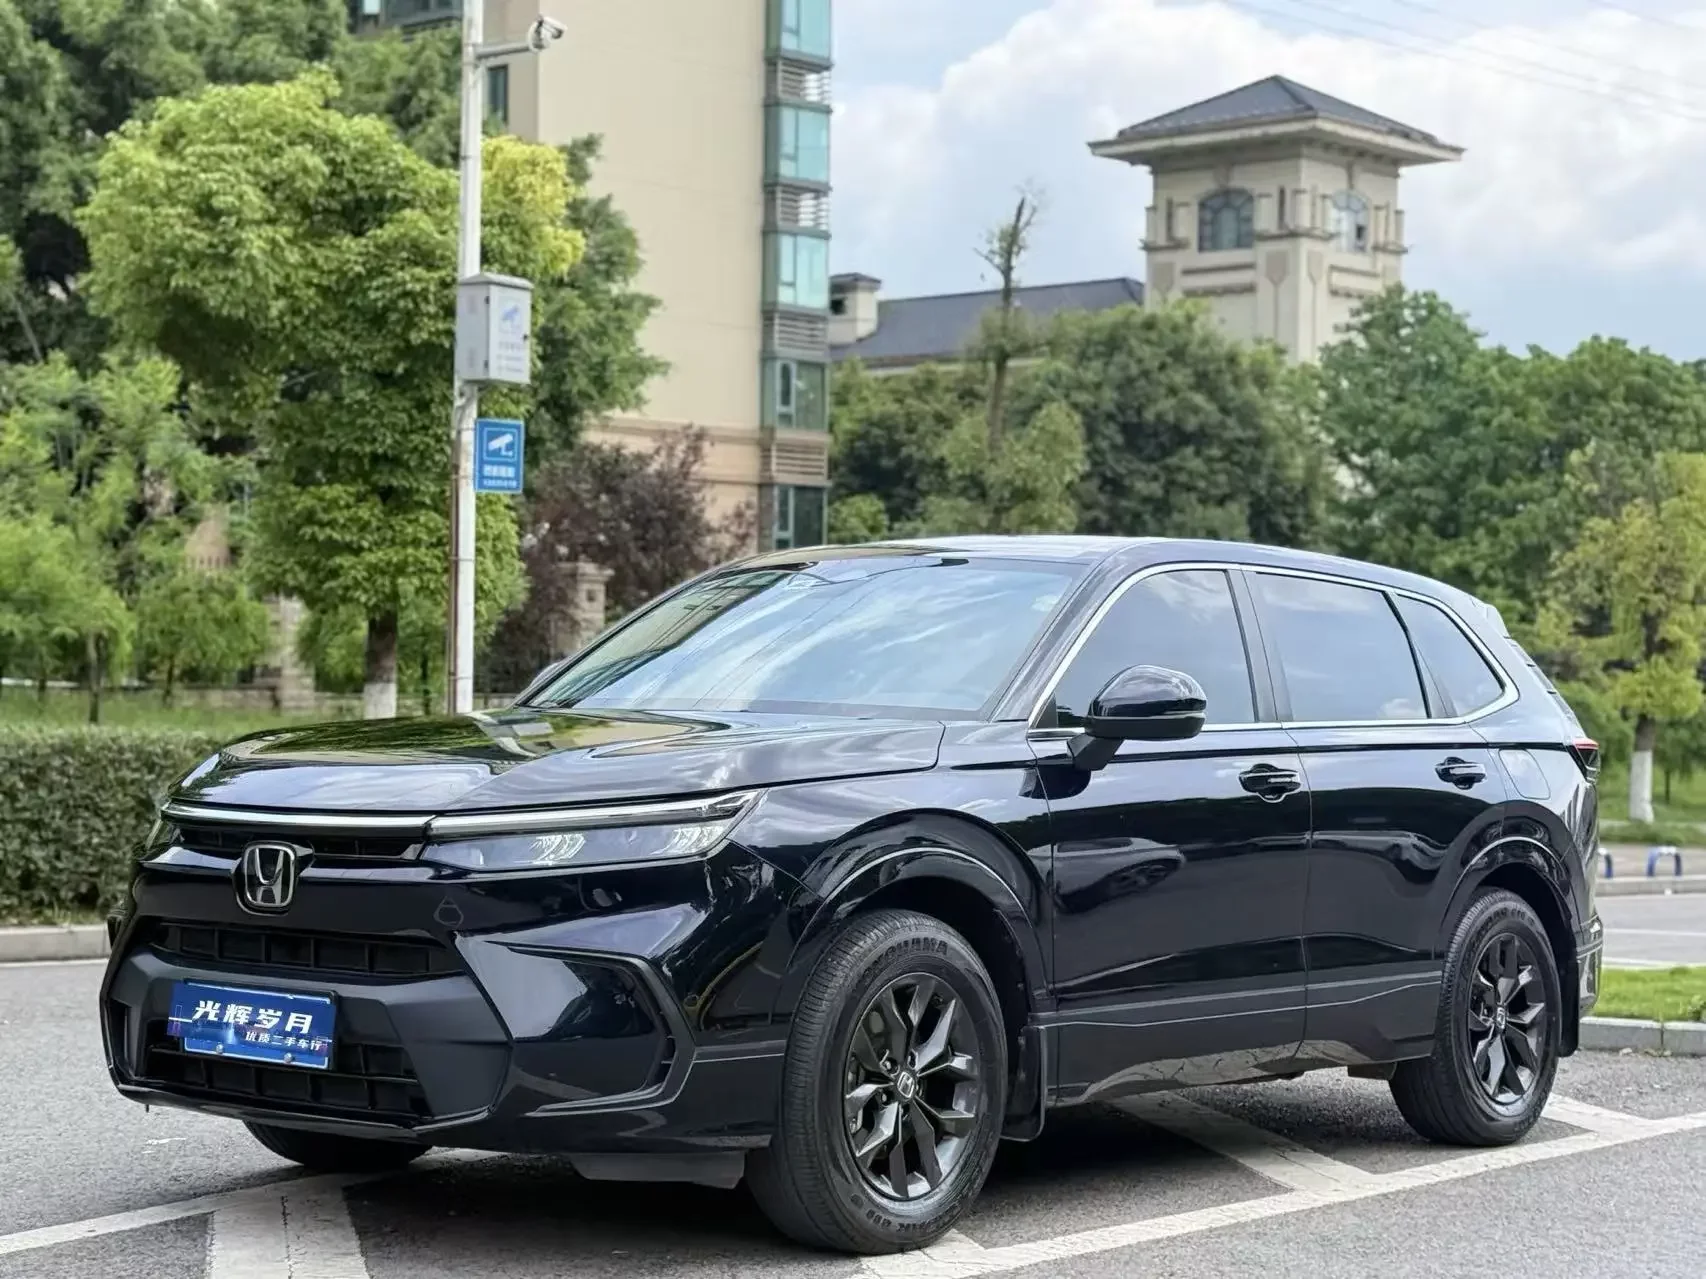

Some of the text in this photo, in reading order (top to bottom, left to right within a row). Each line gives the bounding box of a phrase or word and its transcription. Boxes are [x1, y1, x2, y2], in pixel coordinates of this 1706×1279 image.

[191, 1000, 313, 1034] 光辉岁月
[245, 1031, 323, 1051] 优质二手车行
